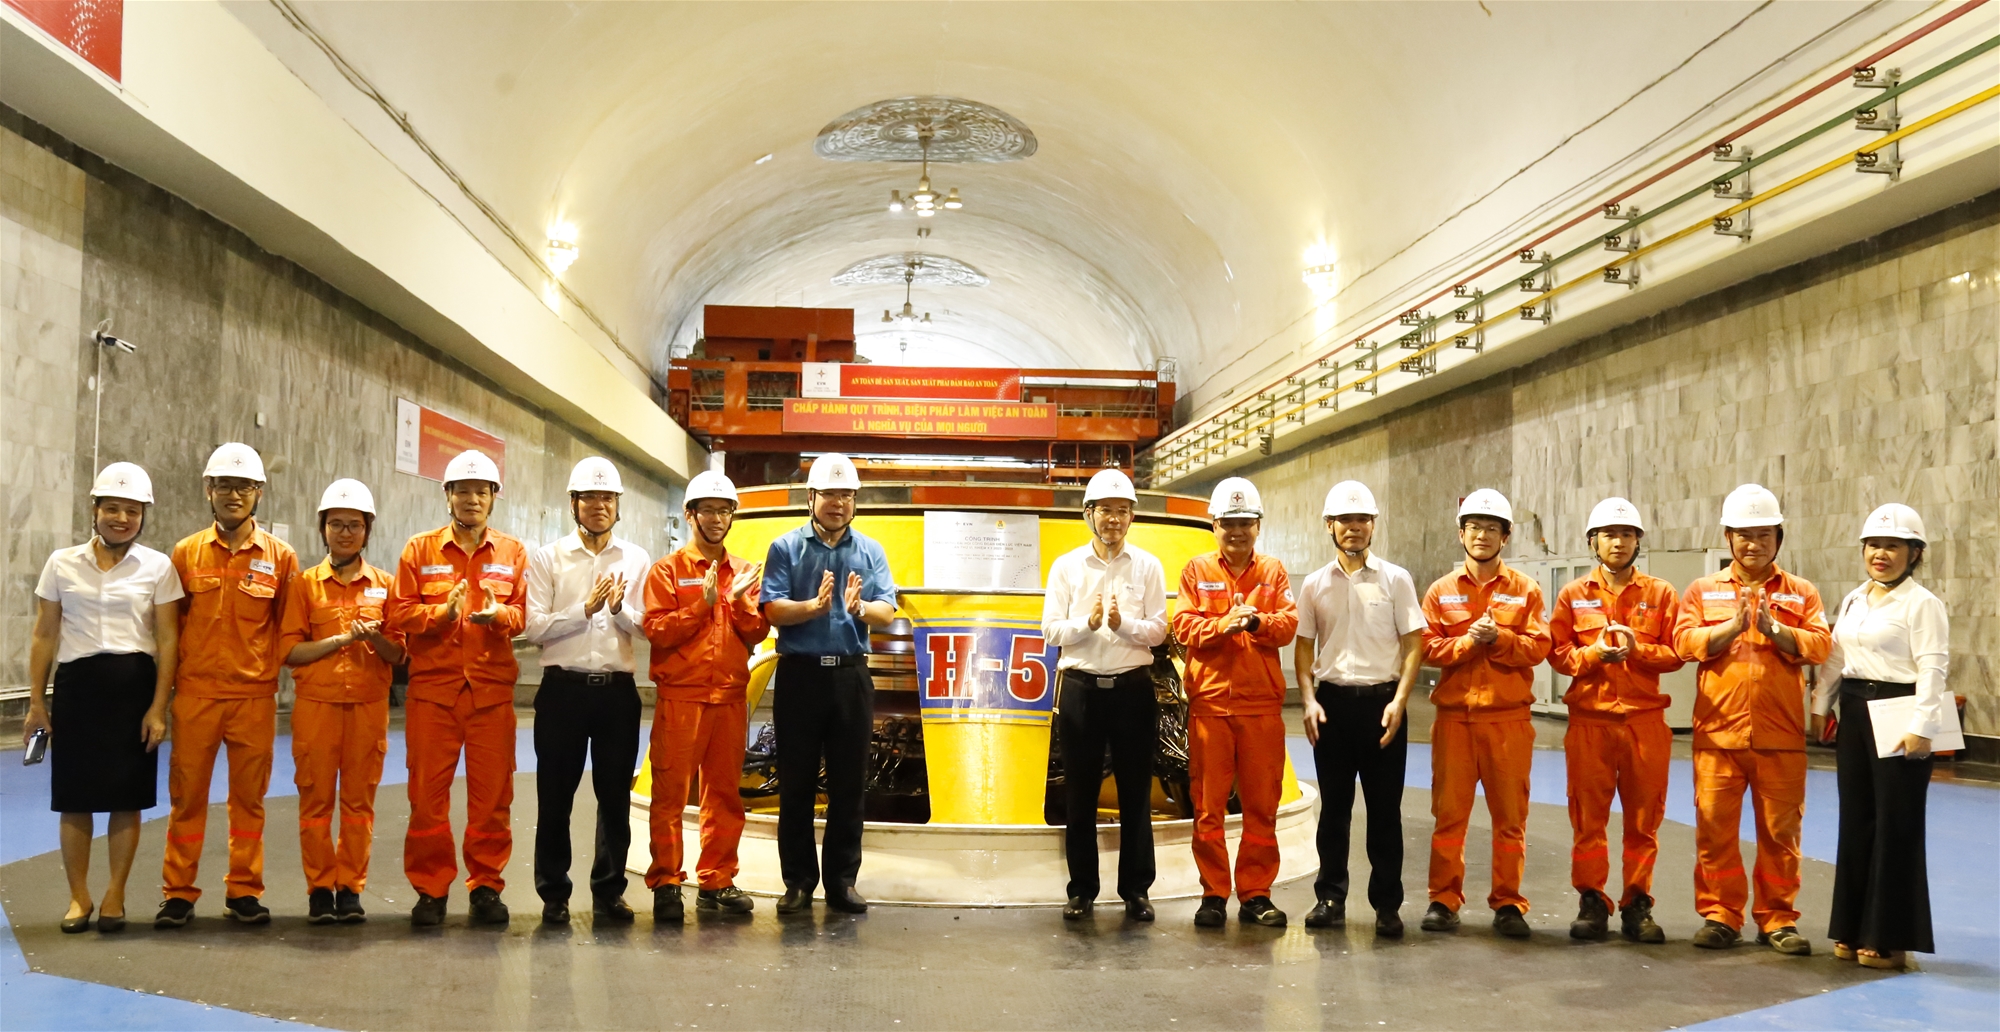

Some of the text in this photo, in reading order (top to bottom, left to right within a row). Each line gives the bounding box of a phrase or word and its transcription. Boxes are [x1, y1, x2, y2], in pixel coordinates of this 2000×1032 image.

[860, 376, 875, 385] TOÀN
[975, 380, 983, 388] AN
[983, 378, 998, 388] TOÀN
[793, 400, 1048, 419] CHẤP HÀNH QUY TRÌNH, BIỆN PHÁP LÀM VIỆC AN TOÀN
[853, 417, 988, 434] LÀ NGHĨA VỤ CỦA MỌI NGƯỜI
[926, 633, 1049, 703] H-5
